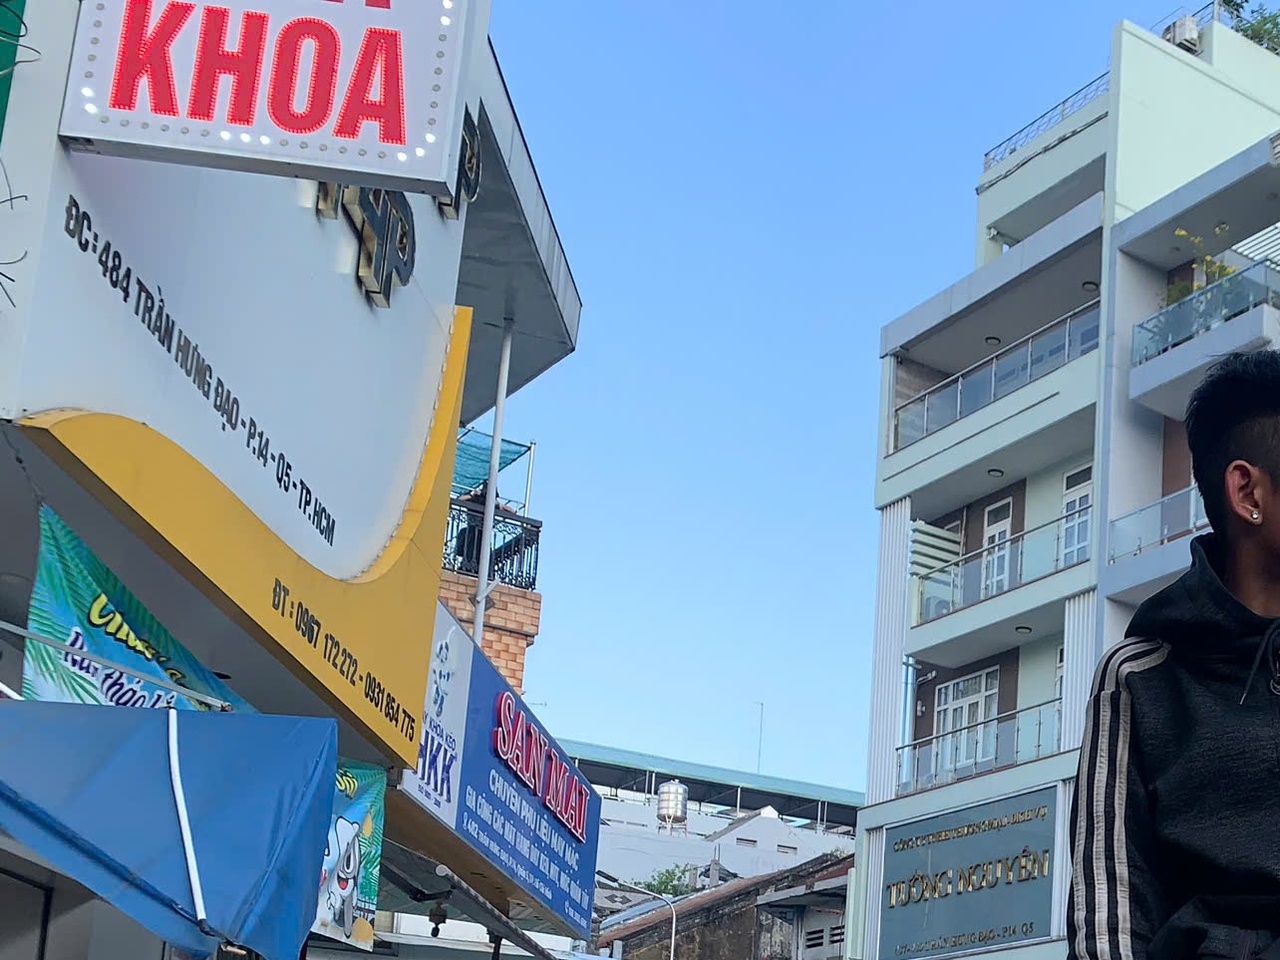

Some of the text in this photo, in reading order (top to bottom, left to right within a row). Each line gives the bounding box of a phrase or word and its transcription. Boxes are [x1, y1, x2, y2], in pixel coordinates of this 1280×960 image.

[109, 0, 405, 145] KHOA
[98, 240, 132, 303] 484
[134, 285, 175, 353] TRẦN
[174, 328, 213, 400] HƯNG
[213, 376, 240, 431] ĐẠO
[276, 453, 292, 493] Q5
[298, 478, 336, 547] TP.HCM
[323, 633, 341, 670] 172
[339, 648, 358, 687] 272
[364, 671, 385, 712] 0931
[385, 692, 401, 728] 854
[400, 708, 416, 742] 775
[489, 769, 520, 816] CHUYÊN
[494, 691, 548, 797] SAN
[542, 748, 590, 843] MAI
[957, 845, 1050, 895] NGUYÊN
